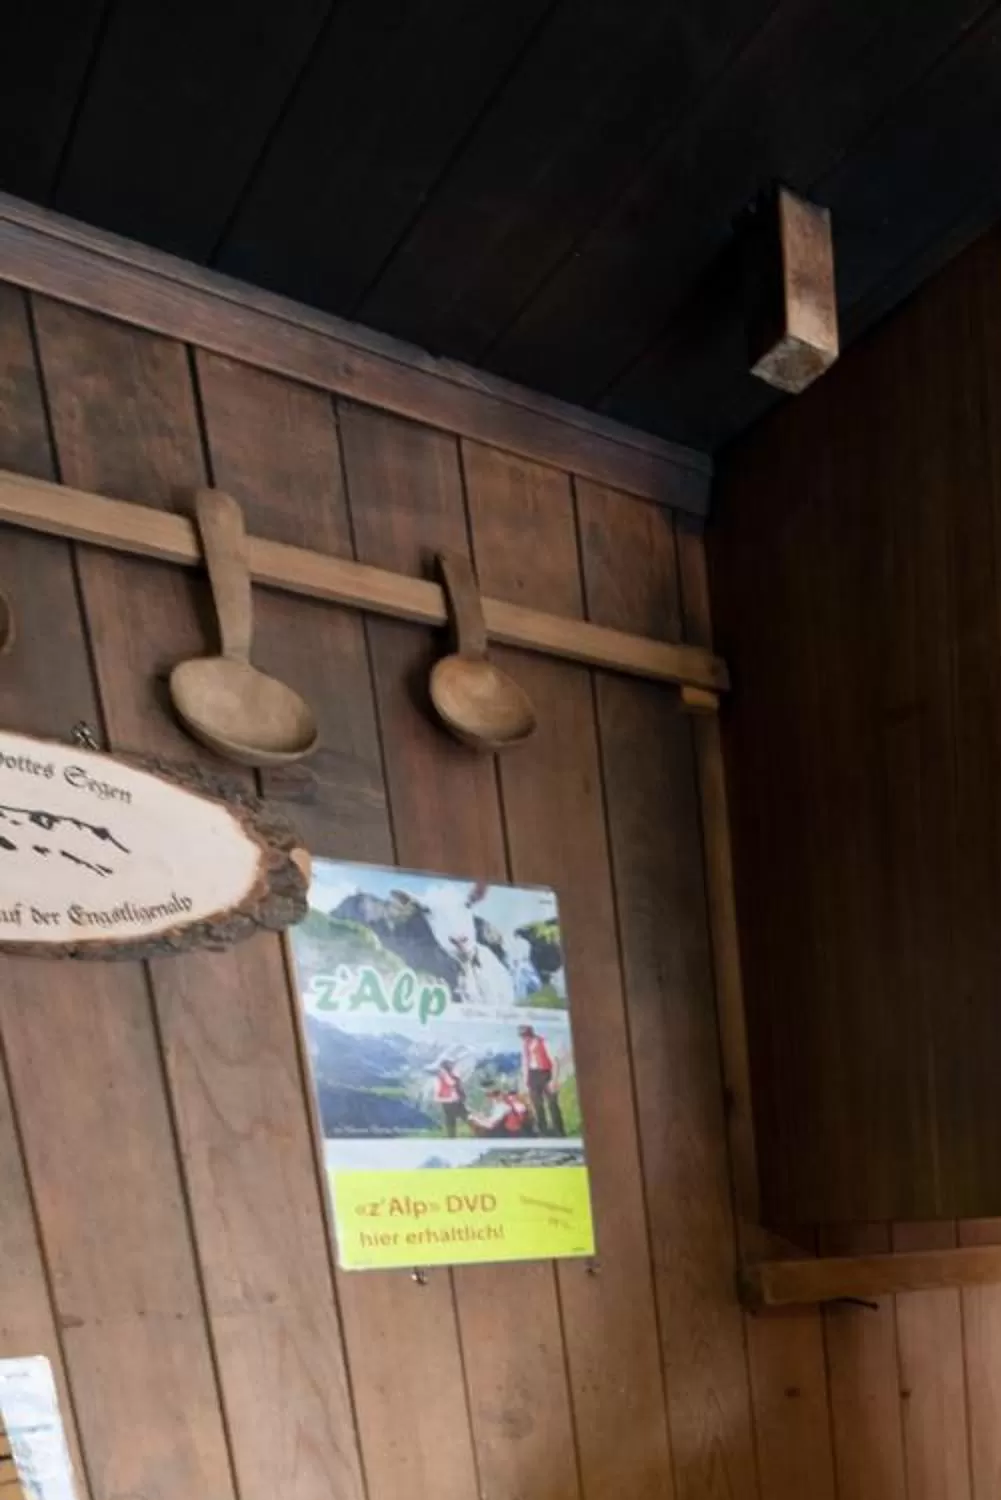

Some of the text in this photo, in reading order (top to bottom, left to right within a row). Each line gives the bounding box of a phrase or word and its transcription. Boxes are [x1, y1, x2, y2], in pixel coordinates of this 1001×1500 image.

[0, 751, 55, 780] ottes
[0, 901, 22, 927] uf
[30, 905, 61, 926] der
[446, 1192, 498, 1213] DVD
[359, 1230, 400, 1248] hier
